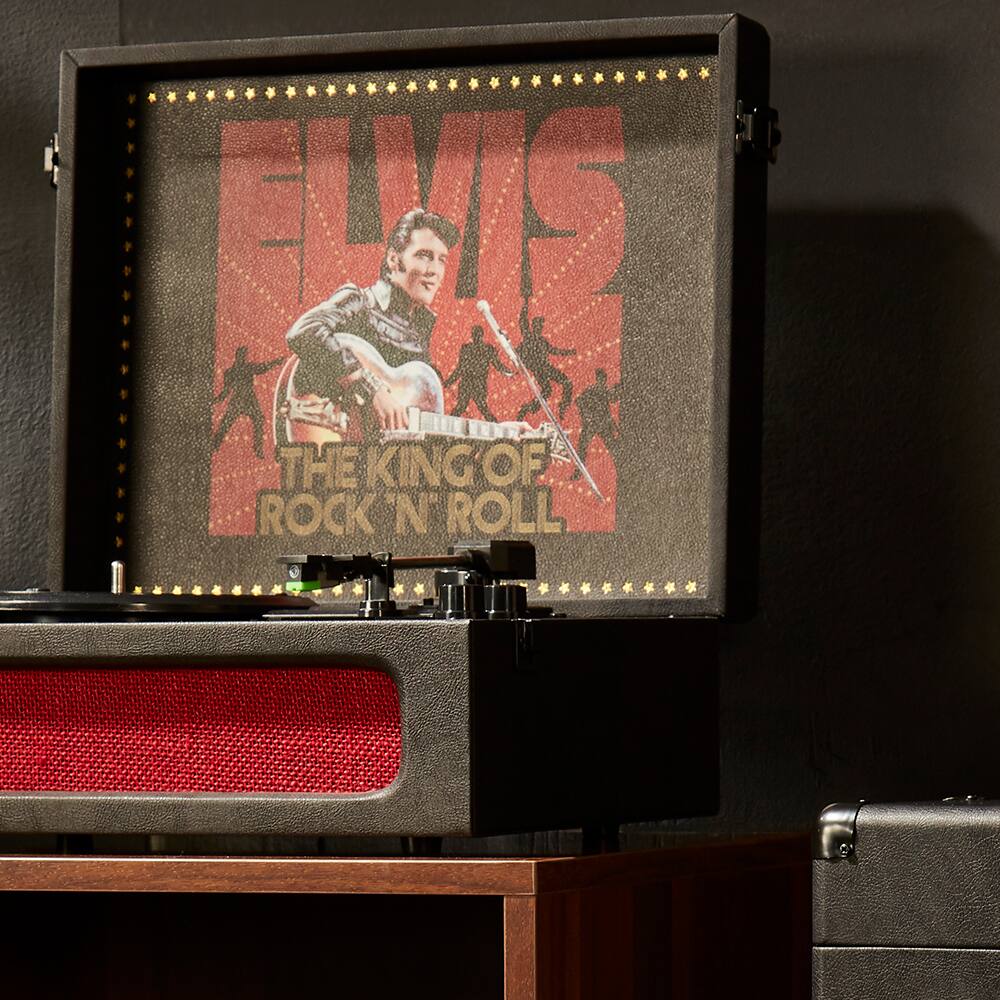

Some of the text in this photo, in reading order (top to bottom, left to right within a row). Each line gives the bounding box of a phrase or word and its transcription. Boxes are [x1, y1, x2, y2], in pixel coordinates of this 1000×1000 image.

[278, 443, 546, 489] THE KING OF
[258, 493, 376, 536] ROCK
[448, 490, 562, 534] ROLL
